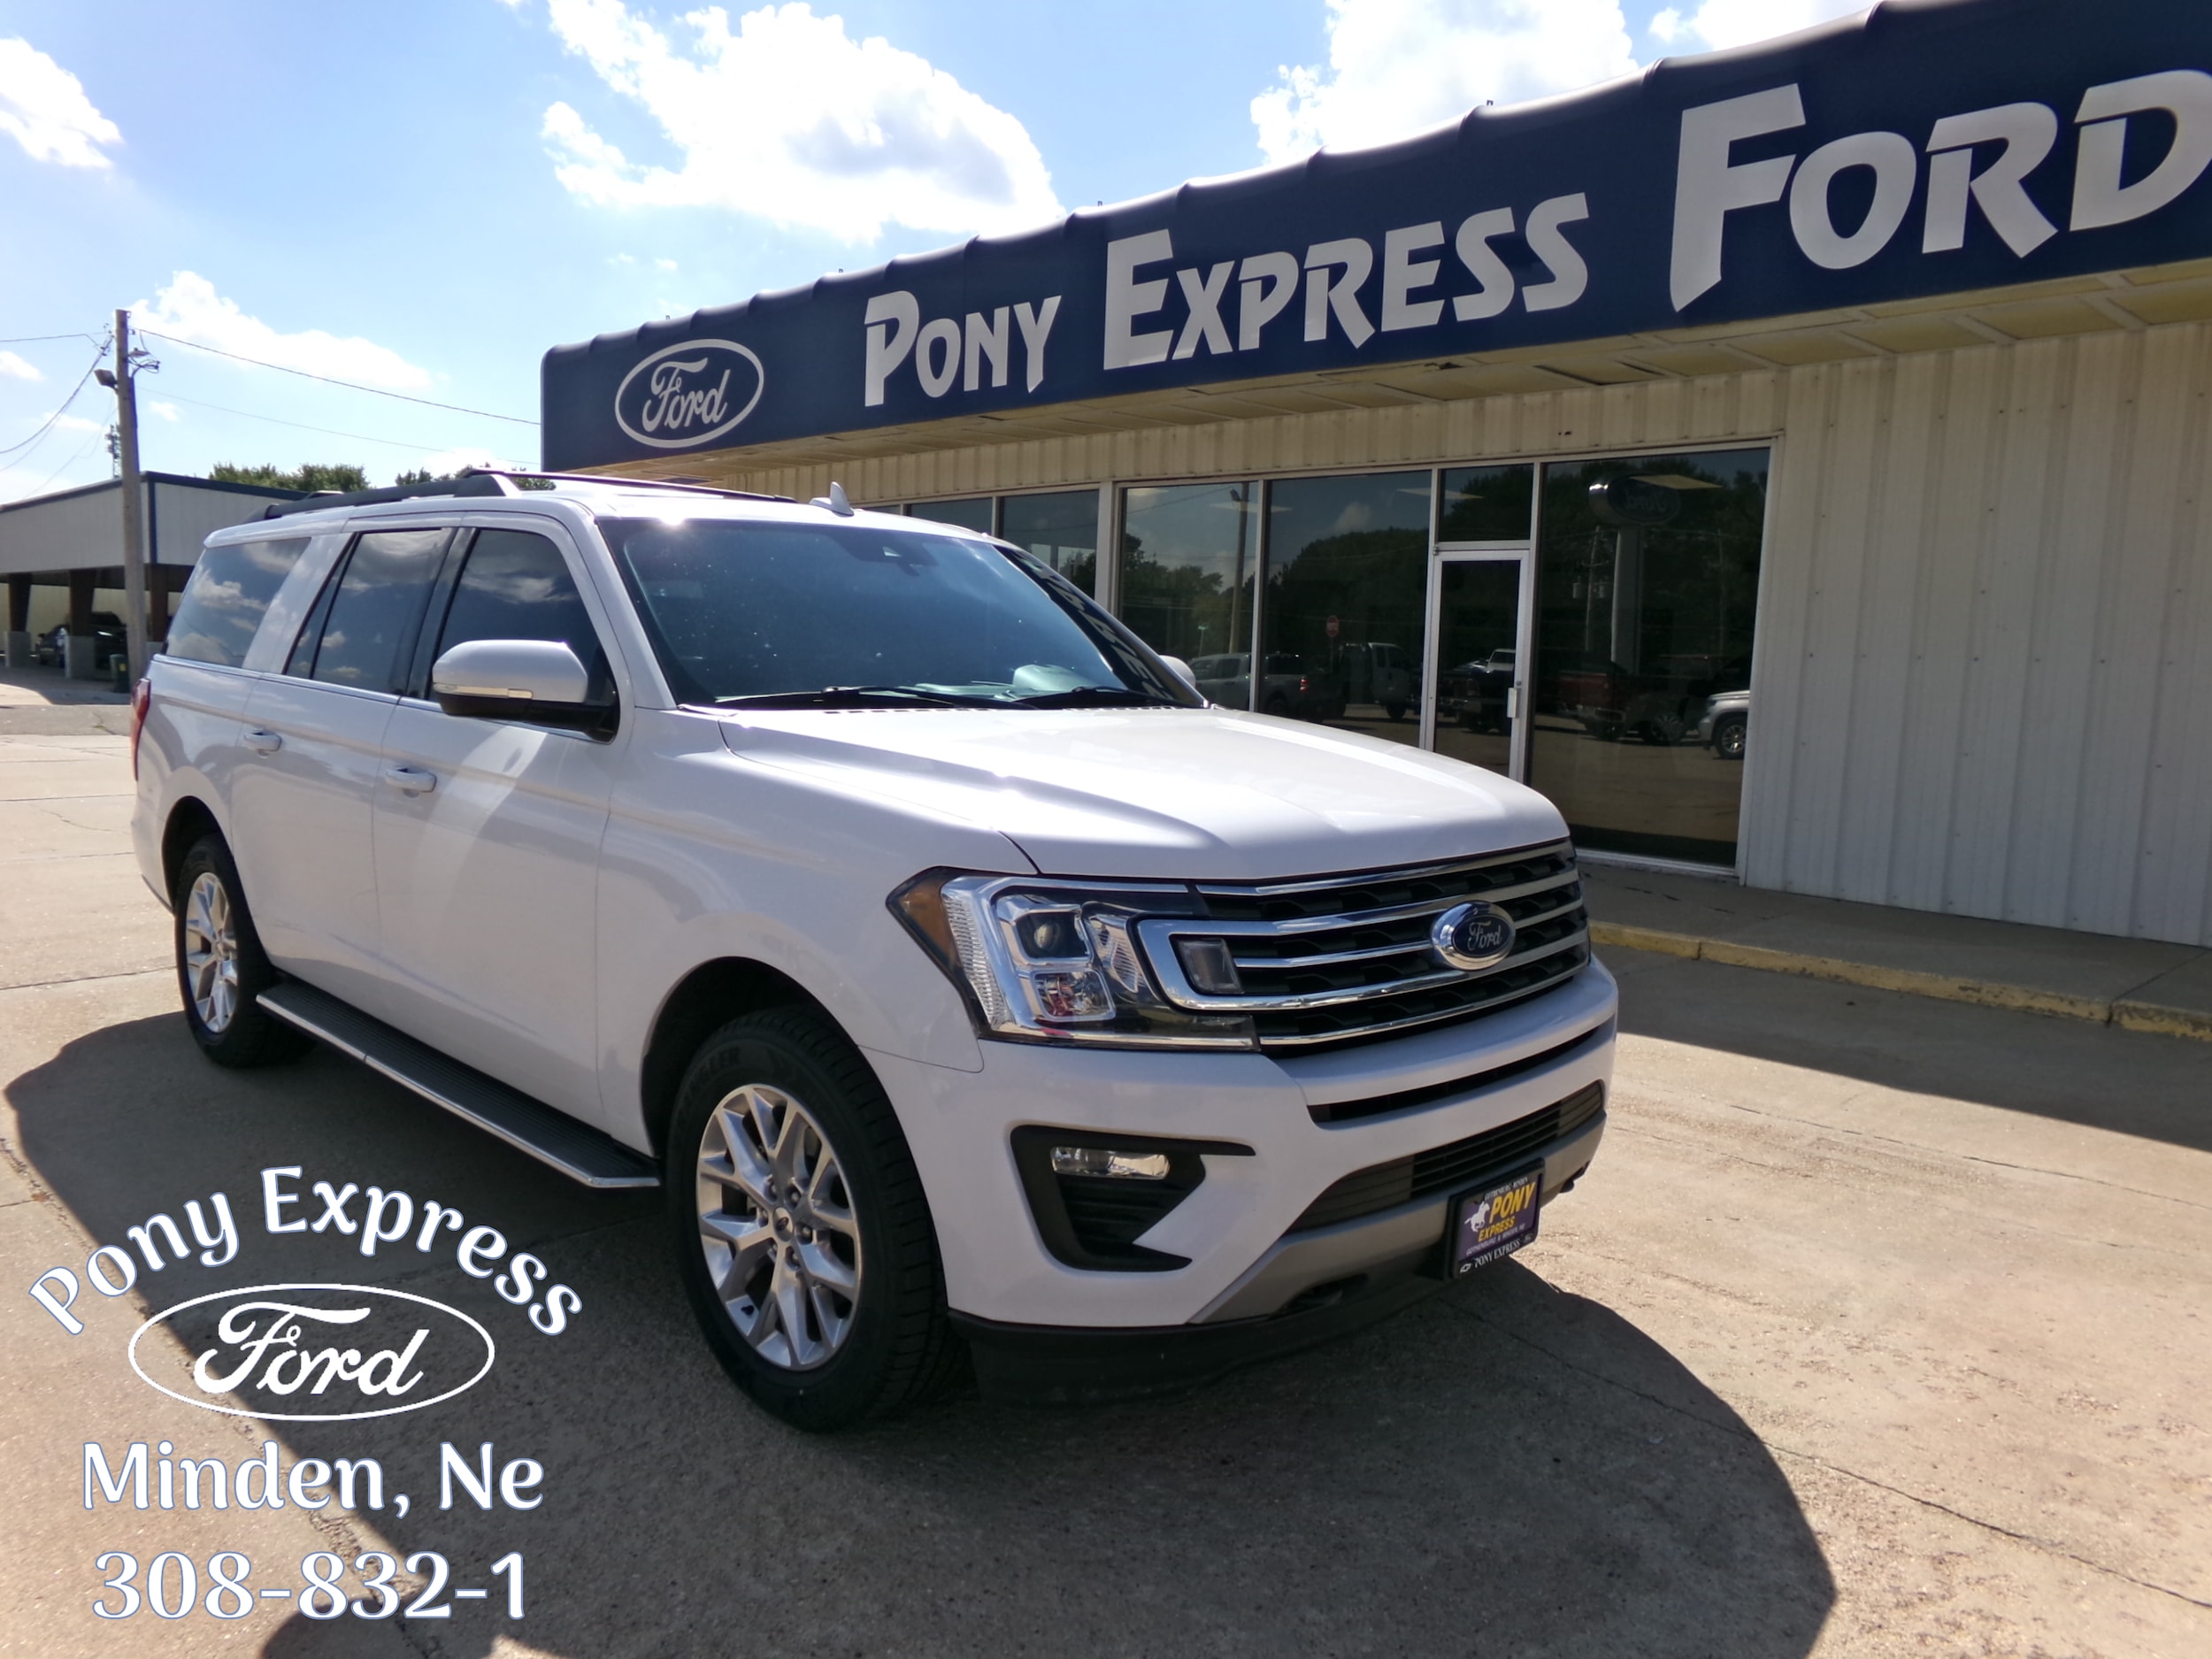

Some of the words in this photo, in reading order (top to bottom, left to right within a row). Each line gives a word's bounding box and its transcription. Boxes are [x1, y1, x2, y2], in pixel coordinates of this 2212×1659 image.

[864, 290, 1063, 407] PONY
[1102, 193, 1589, 370] EXPRESS
[1670, 69, 2212, 312] FORD
[641, 357, 731, 432] Ford
[1467, 920, 1502, 951] Ford
[1488, 1181, 1536, 1224] PONY
[1478, 1216, 1516, 1242] EXPRESS
[1473, 1250, 1494, 1268] PONY
